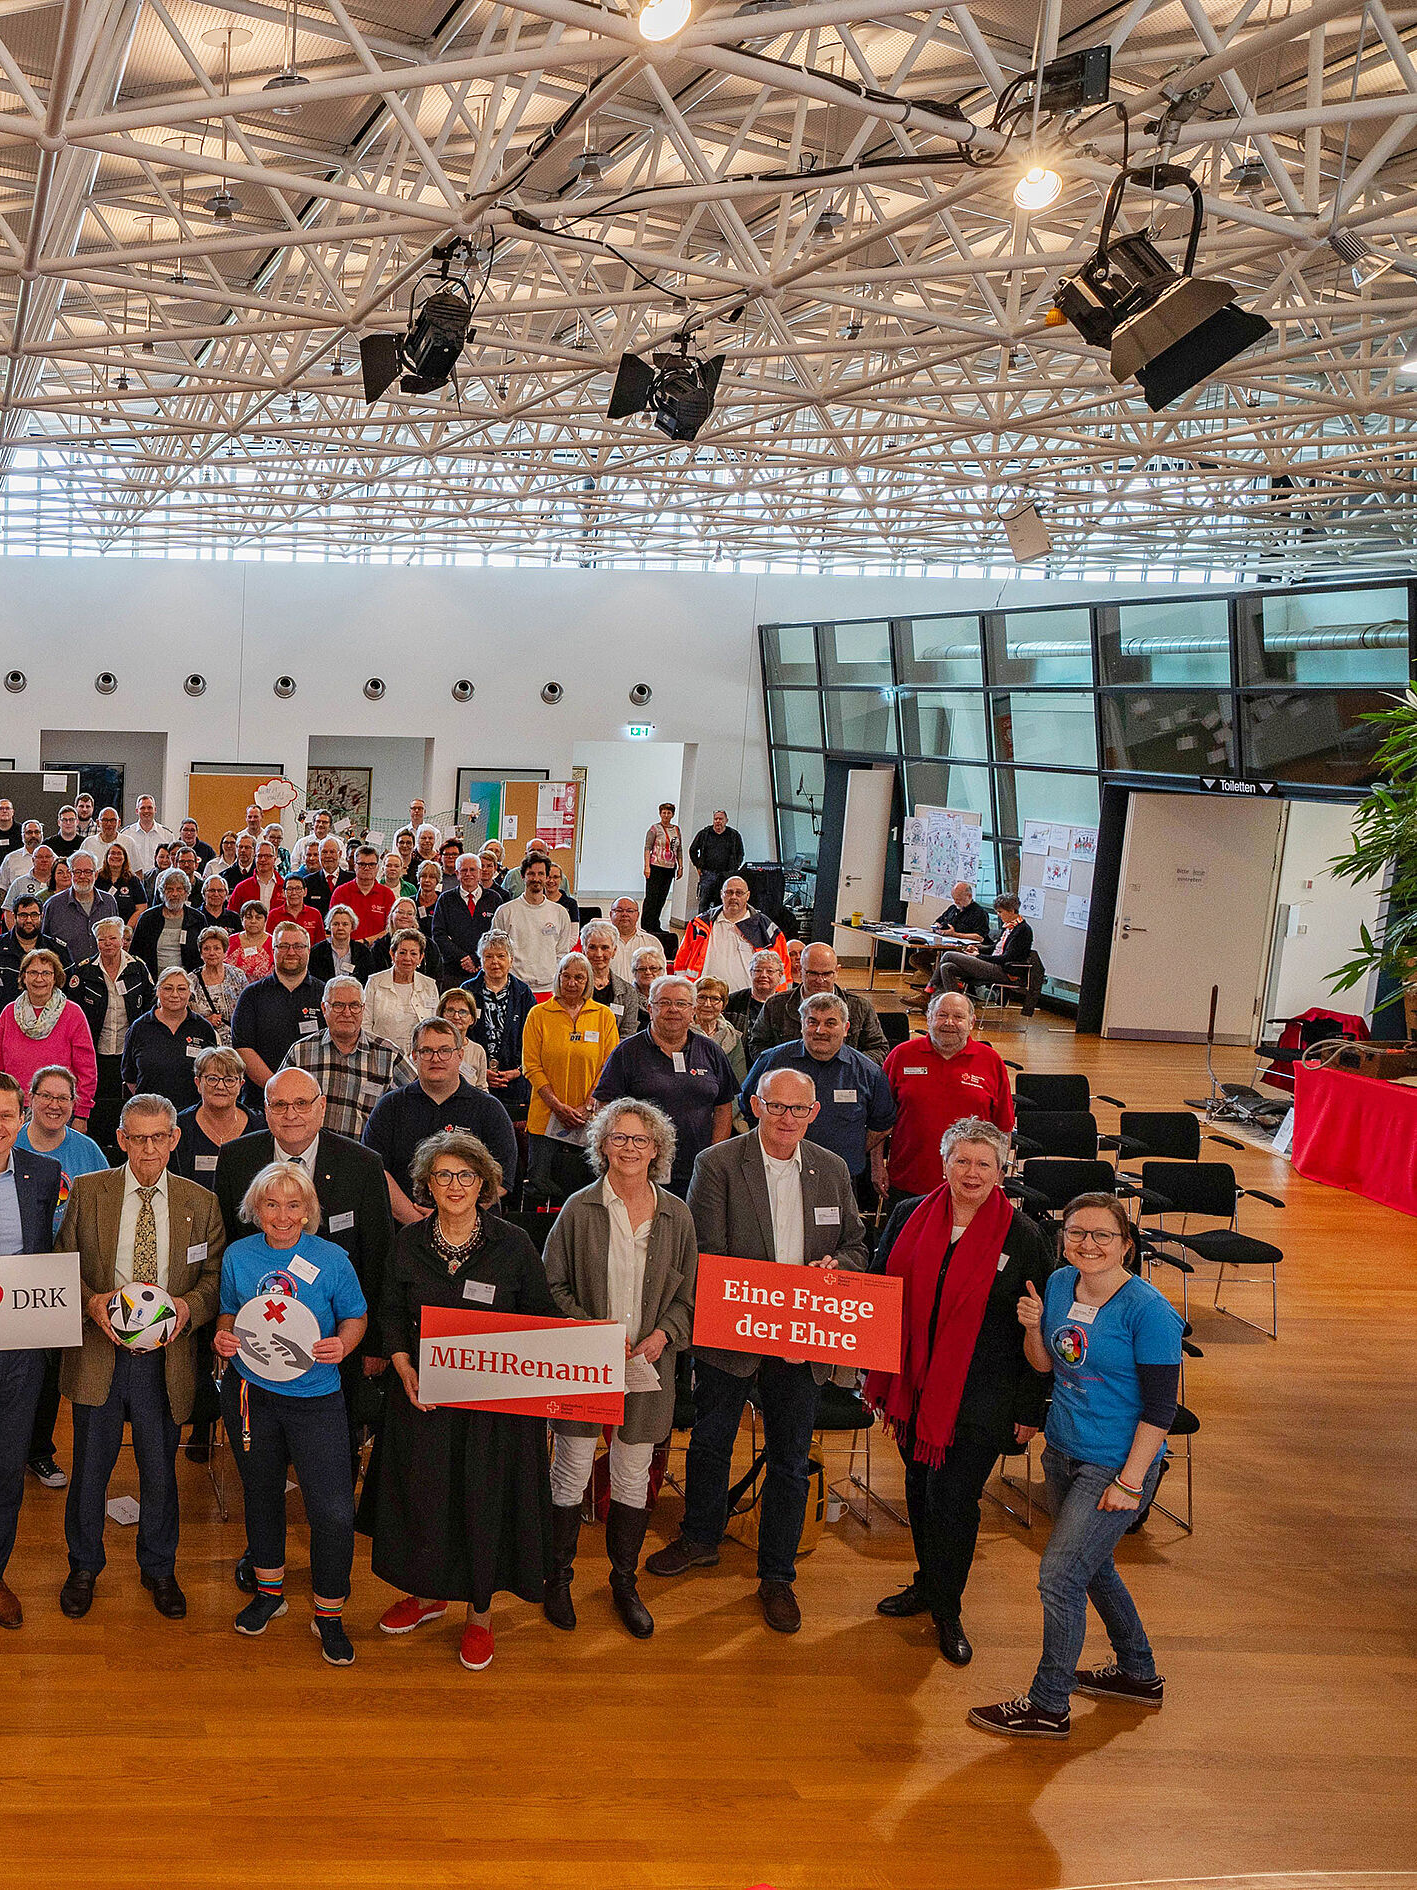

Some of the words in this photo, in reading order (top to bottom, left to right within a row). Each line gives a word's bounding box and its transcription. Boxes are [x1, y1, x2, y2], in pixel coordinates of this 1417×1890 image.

[1220, 779, 1256, 793] Toiletten
[891, 827, 898, 841] 1
[26, 884, 35, 893] 8
[12, 1287, 67, 1310] DRK
[722, 1279, 785, 1307] Eine
[792, 1288, 874, 1323] Frage
[735, 1314, 782, 1340] der
[788, 1320, 857, 1350] Ehre
[430, 1345, 613, 1384] MEHRenamt
